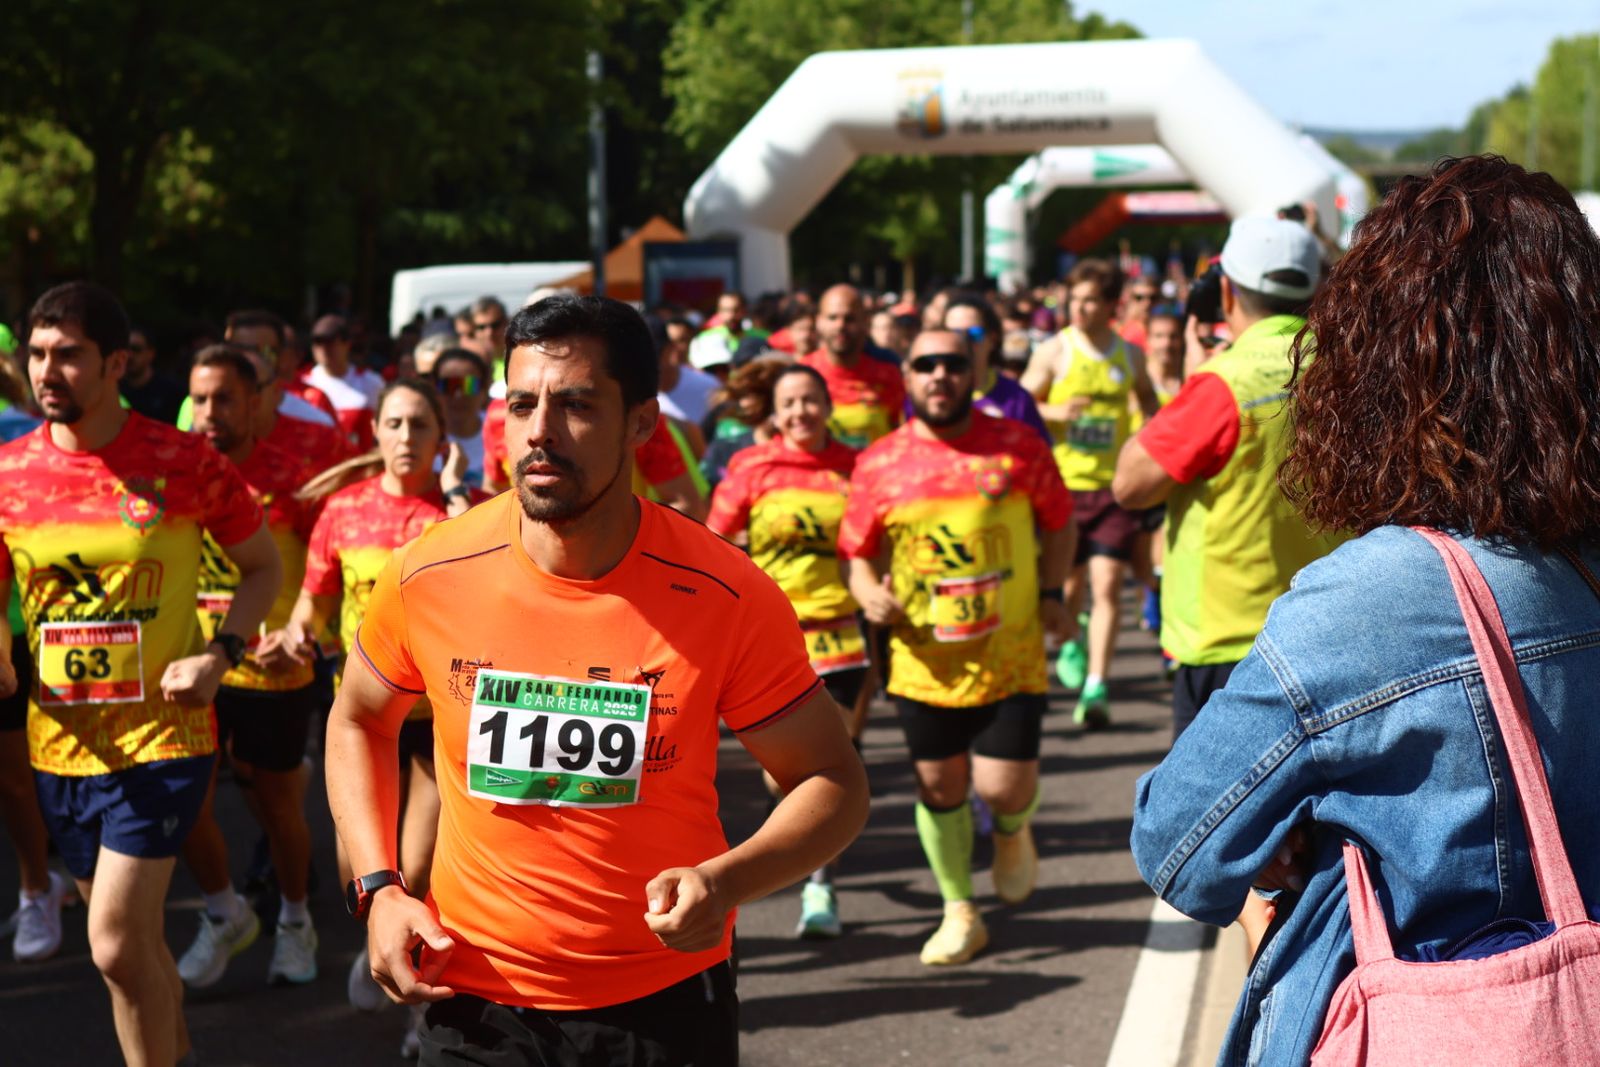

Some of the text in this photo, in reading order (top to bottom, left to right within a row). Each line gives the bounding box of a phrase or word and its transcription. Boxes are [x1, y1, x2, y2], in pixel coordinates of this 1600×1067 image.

[954, 595, 986, 622] 39
[814, 629, 843, 653] 41
[64, 647, 111, 681] 63
[479, 676, 643, 705] XIV SAN FERNANDO
[523, 693, 600, 713] CARRERA
[479, 710, 636, 776] 1199
